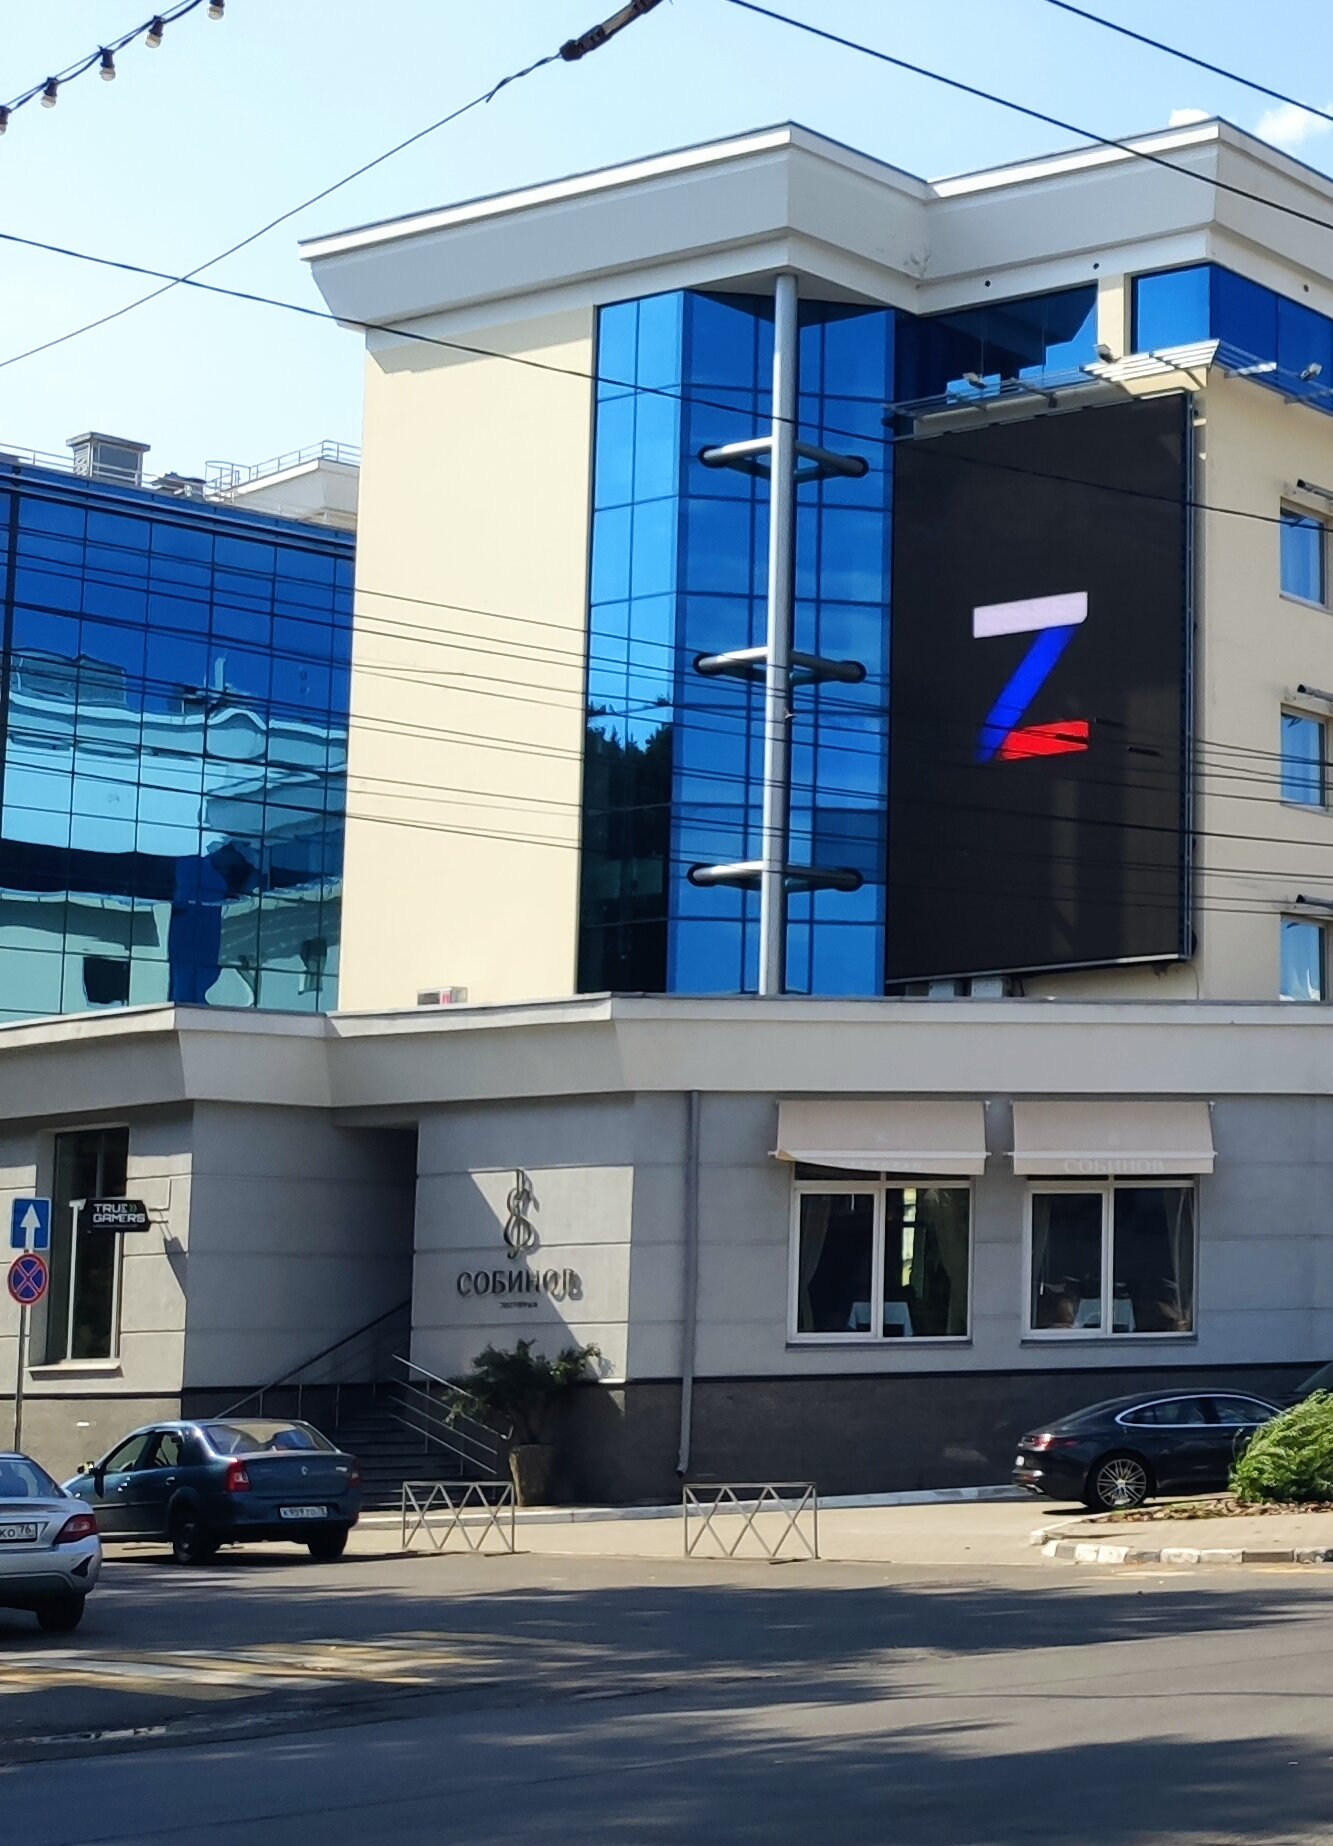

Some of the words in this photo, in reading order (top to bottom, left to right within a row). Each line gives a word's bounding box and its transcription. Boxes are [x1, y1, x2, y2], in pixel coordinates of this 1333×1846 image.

[974, 591, 1089, 764] Z
[93, 1203, 128, 1213] TRUE
[93, 1213, 146, 1223] GAMERS
[457, 1269, 581, 1298] СОБИНОВ
